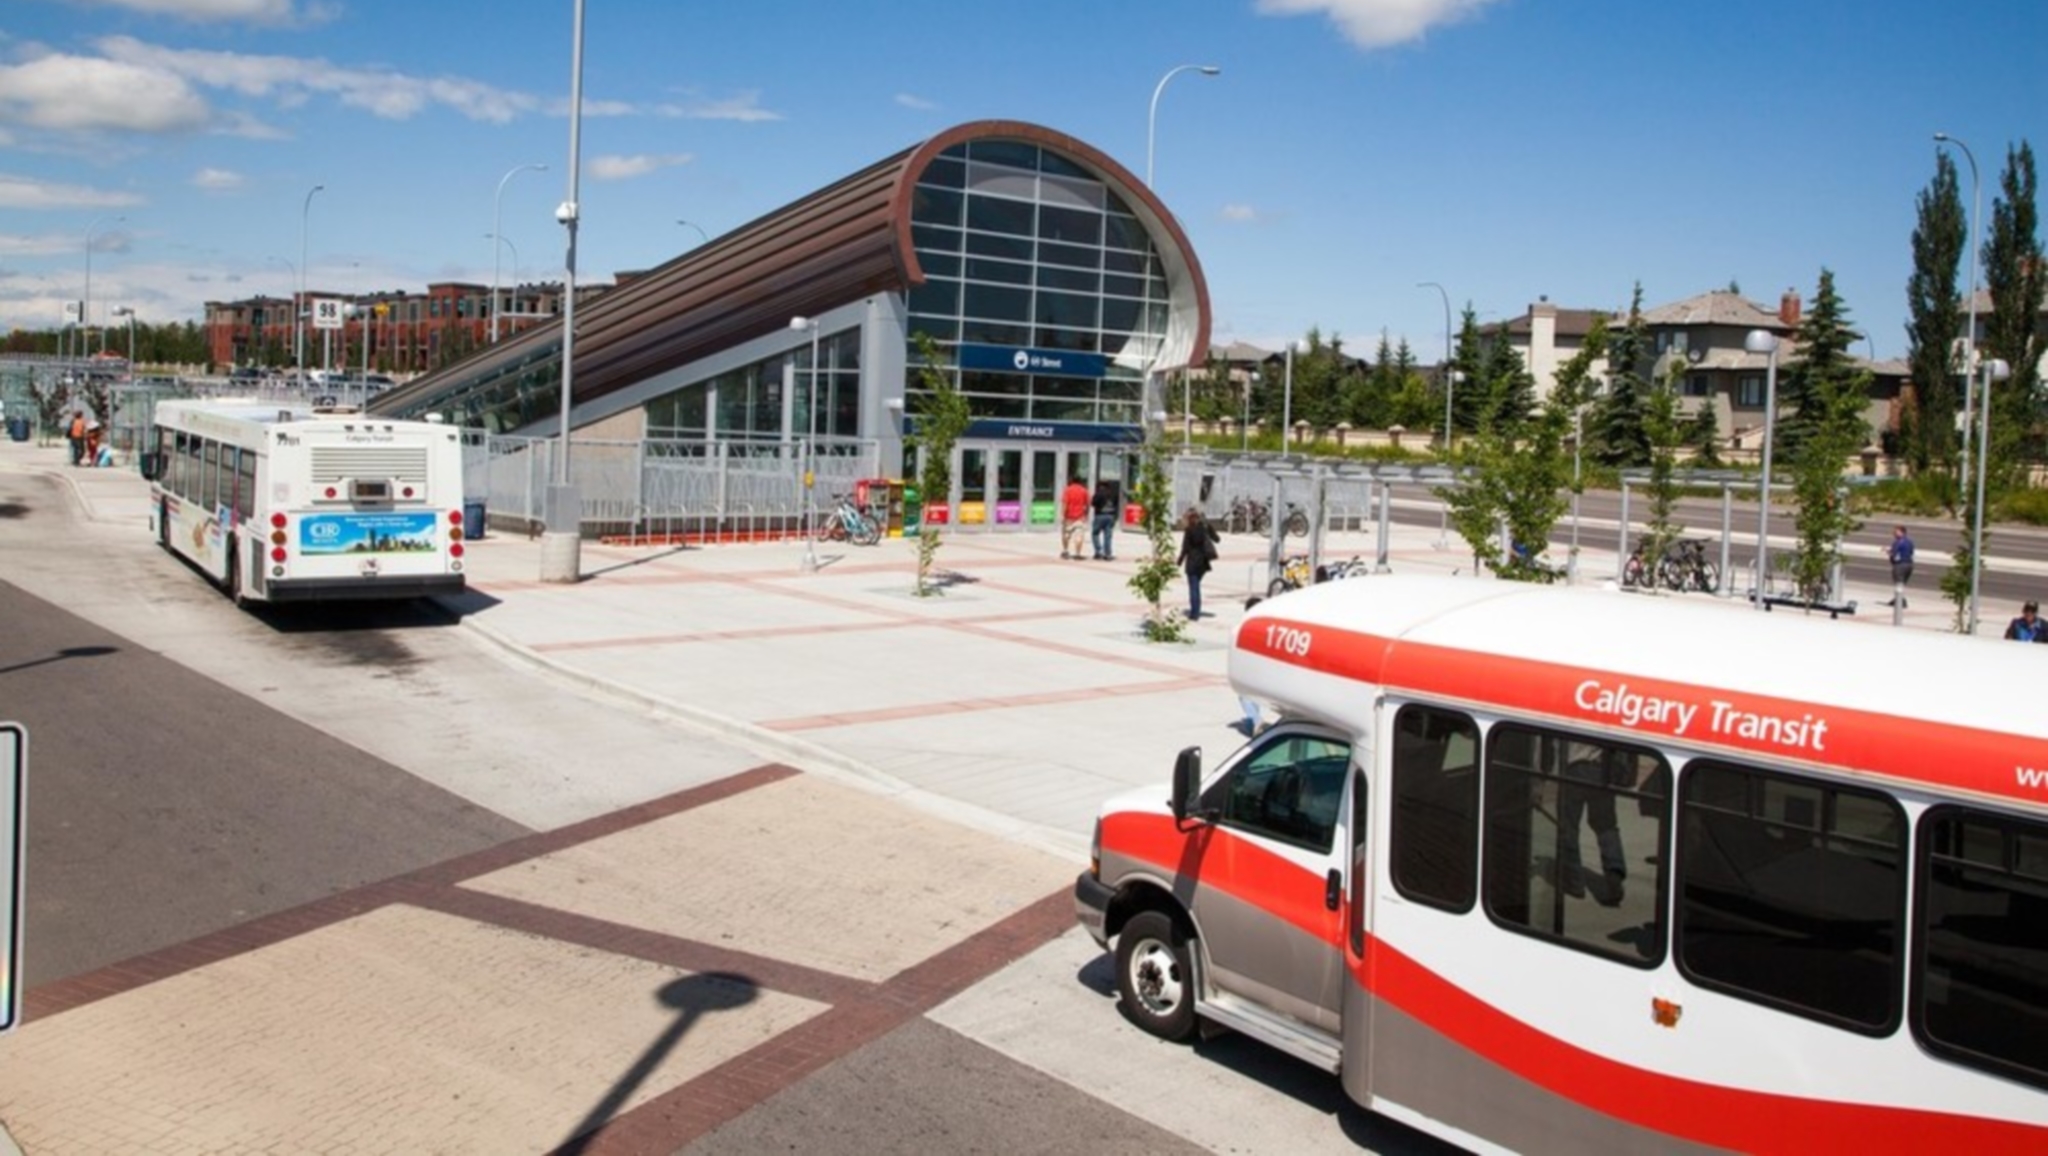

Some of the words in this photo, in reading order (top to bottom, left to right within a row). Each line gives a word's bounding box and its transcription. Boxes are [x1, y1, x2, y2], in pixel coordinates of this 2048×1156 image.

[319, 303, 337, 318] 98
[1041, 357, 1062, 368] Street
[1008, 425, 1054, 437] ENTRANCE
[276, 432, 300, 446] 7701
[346, 435, 371, 443] Calgary
[1266, 624, 1312, 656] 1709
[1575, 680, 1698, 735] Calgary
[1710, 700, 1828, 750] Transit
